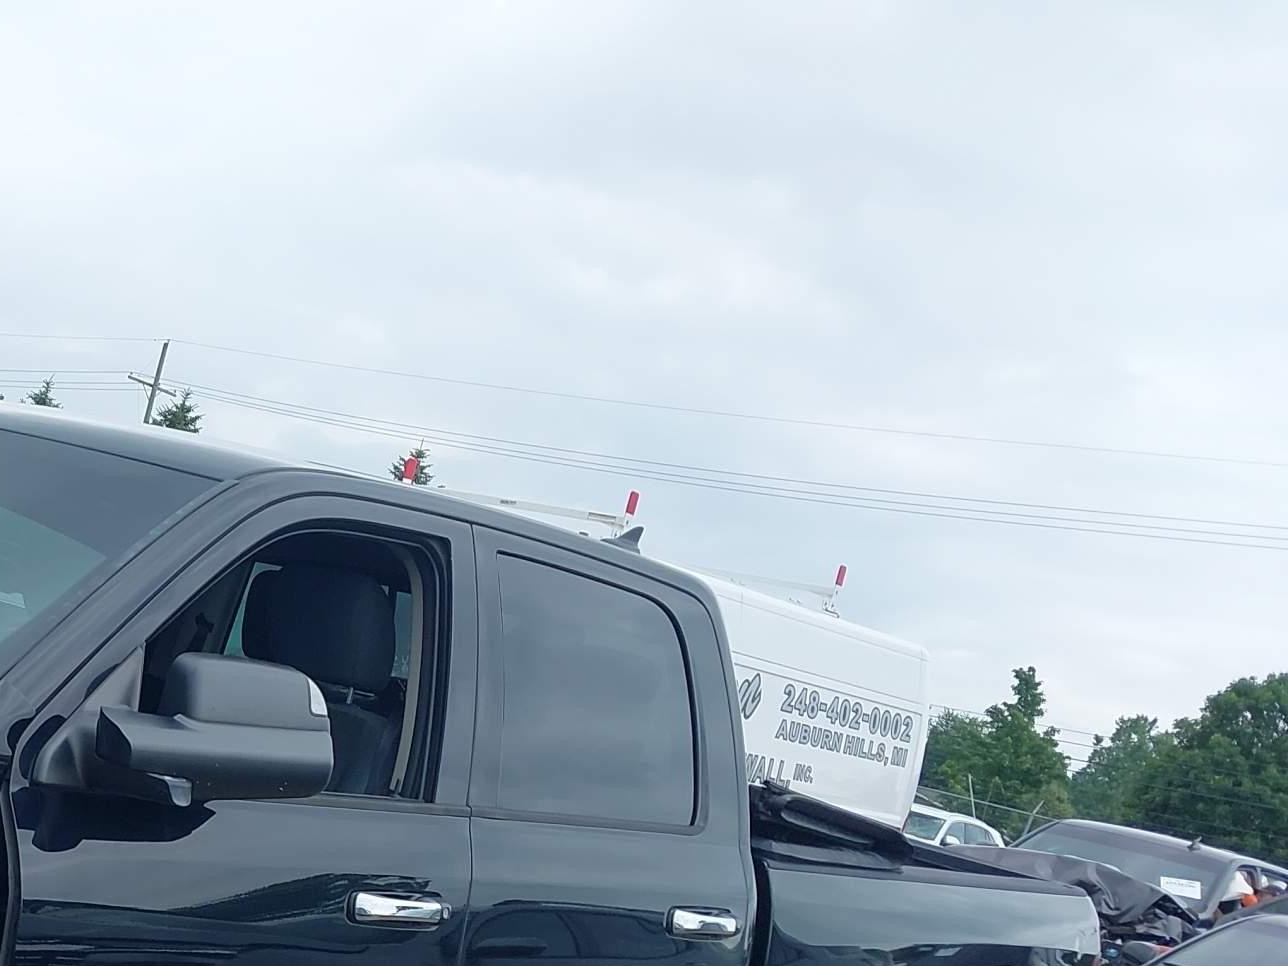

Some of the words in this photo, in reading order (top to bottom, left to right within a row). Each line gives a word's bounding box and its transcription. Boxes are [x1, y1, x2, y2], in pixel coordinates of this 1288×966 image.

[780, 683, 914, 743] 248-402-0002
[775, 718, 843, 752] AUBURN
[843, 736, 889, 767] HILLS,
[890, 745, 909, 769] MI
[793, 763, 814, 784] INC.
